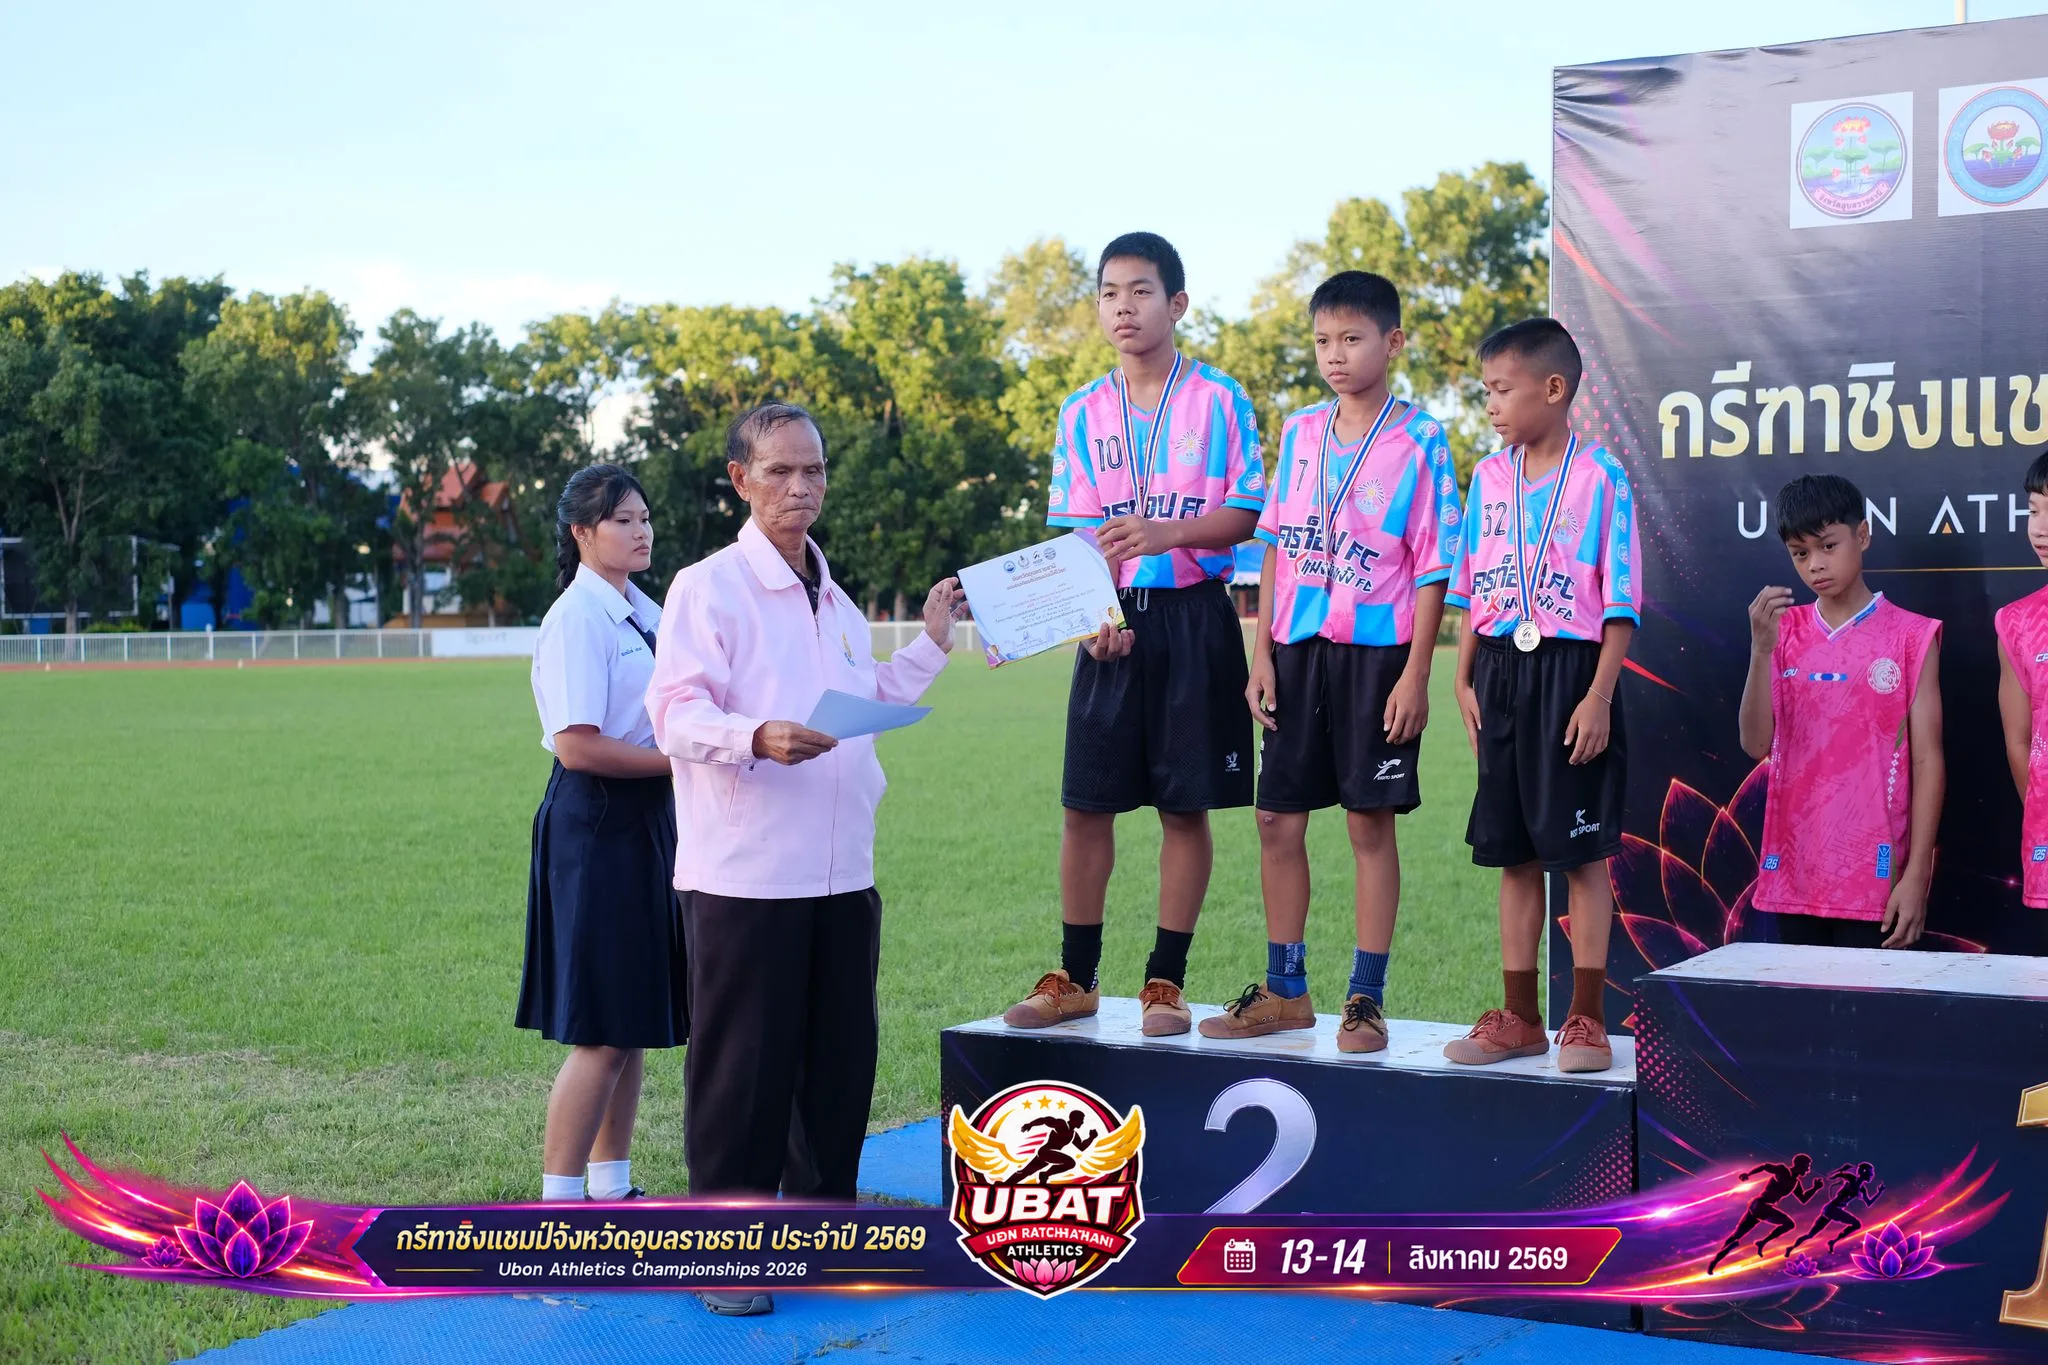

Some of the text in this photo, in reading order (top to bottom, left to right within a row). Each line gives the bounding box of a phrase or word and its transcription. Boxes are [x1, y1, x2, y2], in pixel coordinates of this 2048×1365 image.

[1094, 434, 1124, 473] 10
[1298, 459, 1309, 492] 7
[1482, 501, 1508, 538] 32
[1737, 497, 1897, 539] UN
[1343, 540, 1381, 573] FC
[1547, 571, 1575, 601] FC
[1578, 822, 1600, 835] SPORT
[1202, 1077, 1318, 1214] 2
